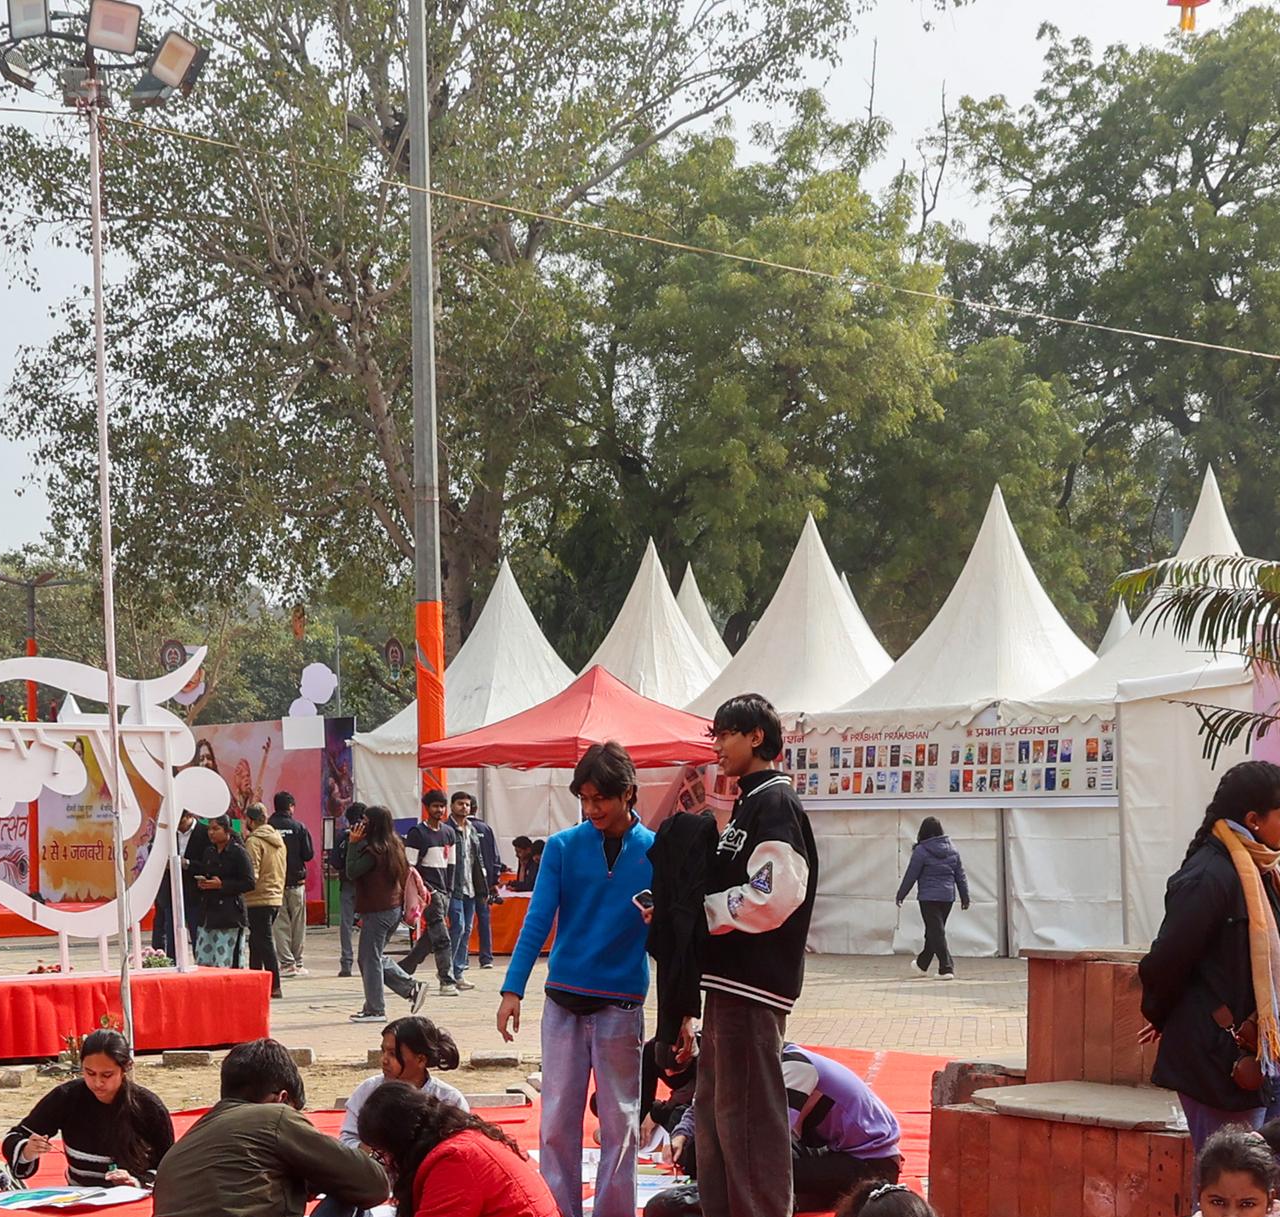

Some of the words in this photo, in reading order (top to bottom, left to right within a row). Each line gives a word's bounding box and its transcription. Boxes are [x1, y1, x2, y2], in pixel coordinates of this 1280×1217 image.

[850, 732, 882, 742] PRABHAT
[884, 730, 929, 741] PRAKASHAN
[975, 726, 1007, 738] प्रभात
[1009, 725, 1060, 737] प्रकाशन
[50, 840, 59, 861] से
[62, 845, 68, 861] 4
[70, 839, 105, 861] जनवरी
